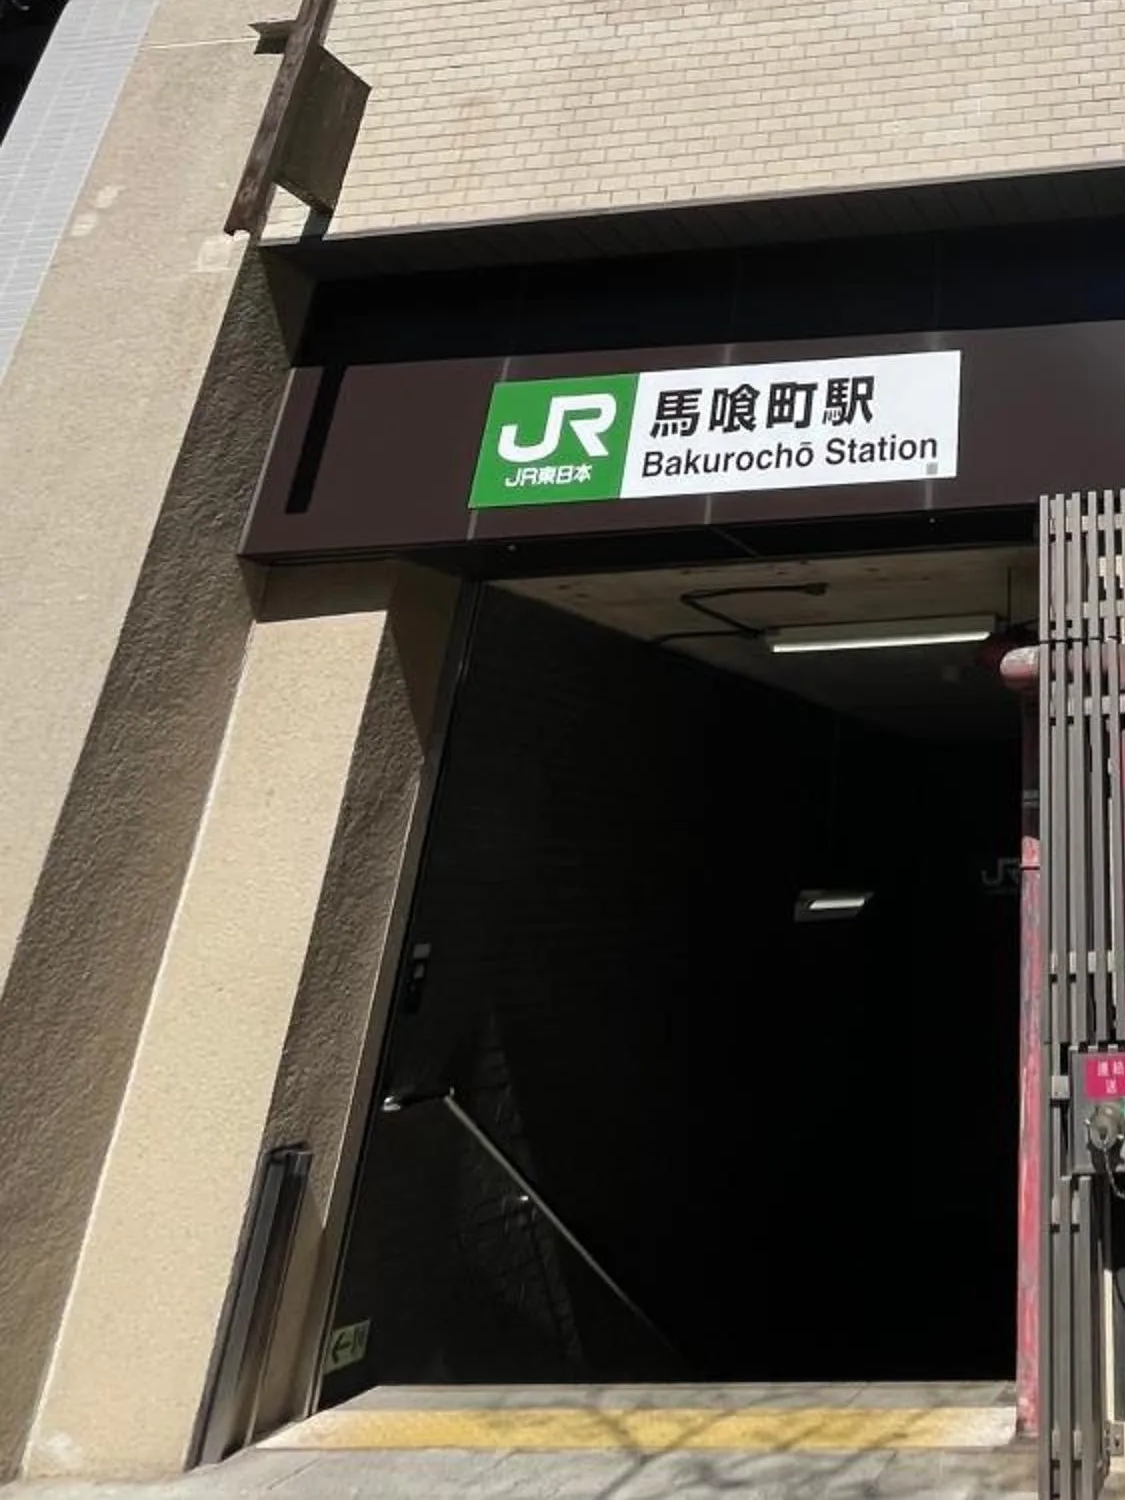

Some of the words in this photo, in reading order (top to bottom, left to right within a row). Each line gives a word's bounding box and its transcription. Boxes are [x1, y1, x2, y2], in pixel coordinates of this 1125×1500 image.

[497, 393, 617, 463] JR
[650, 375, 875, 438] 馬喰町駅
[505, 465, 592, 487] JR東日本
[642, 441, 814, 478] Bakurochō
[825, 435, 938, 465] Station
